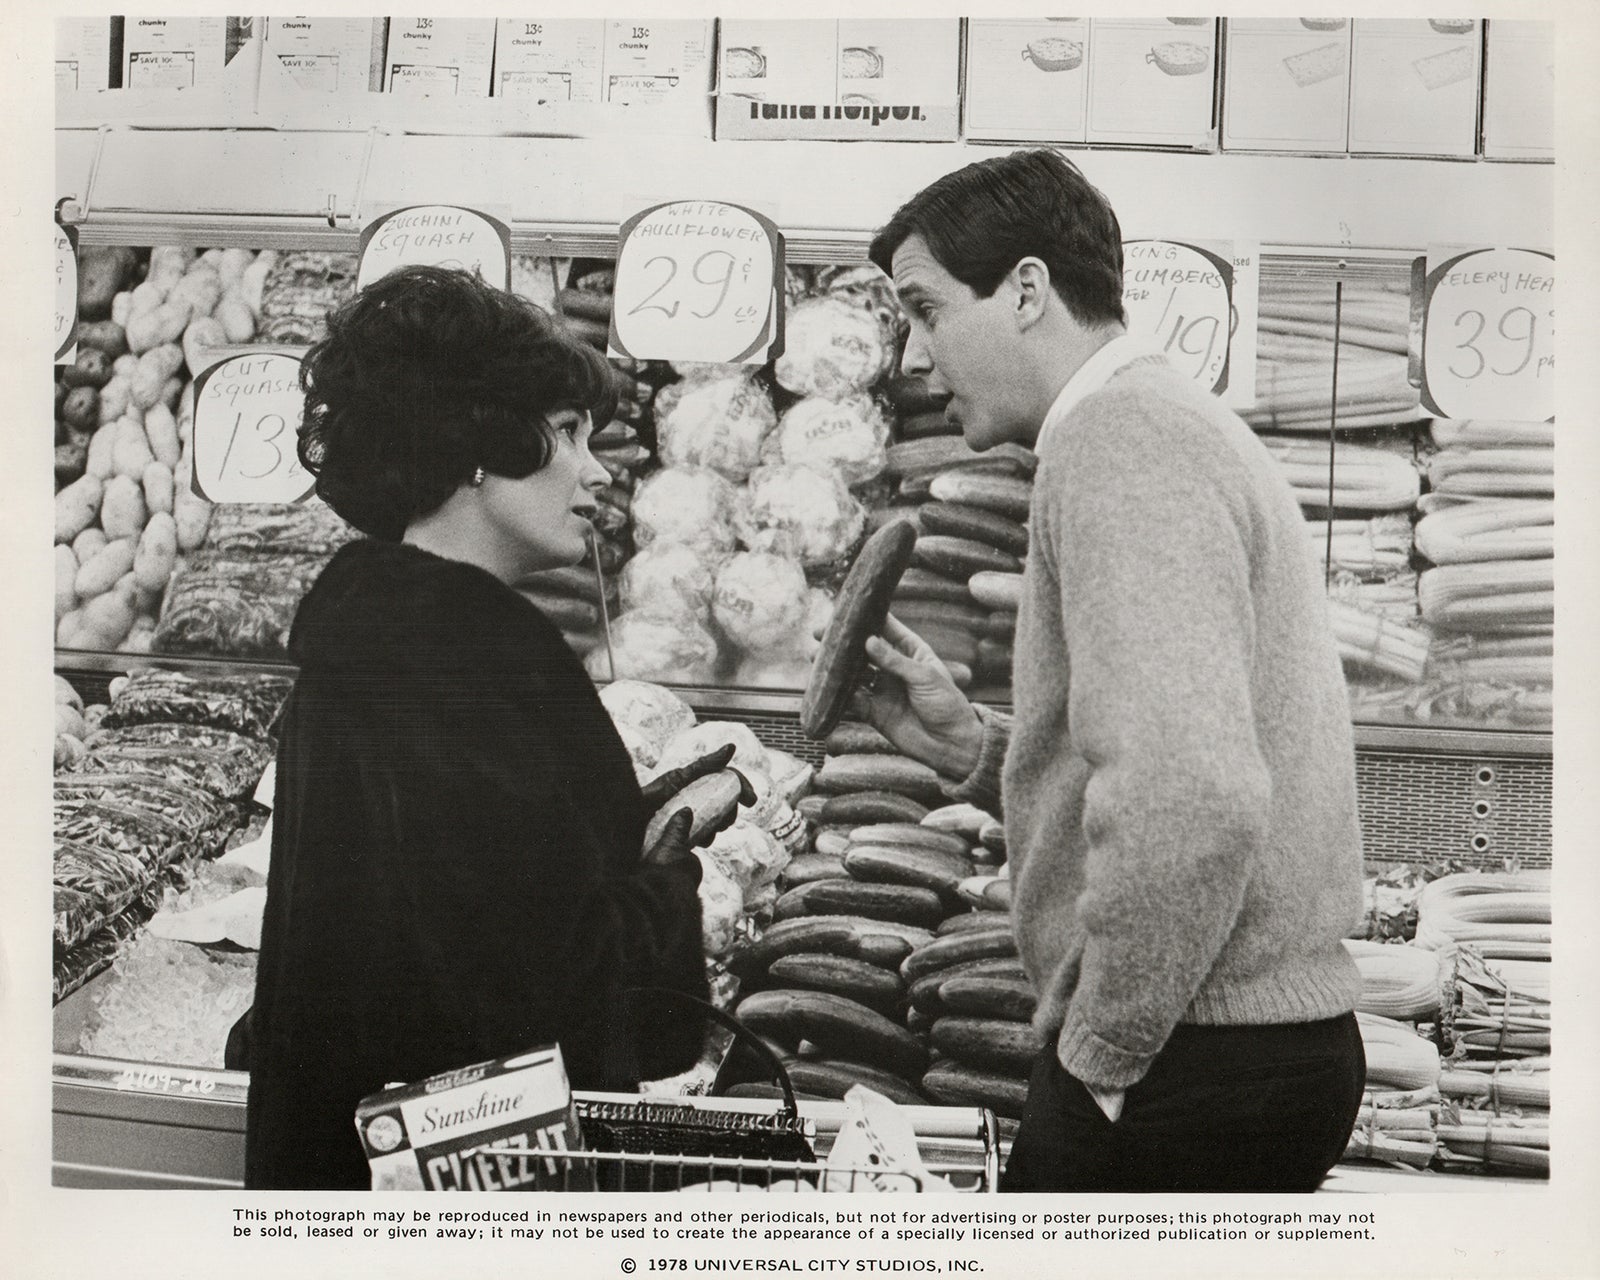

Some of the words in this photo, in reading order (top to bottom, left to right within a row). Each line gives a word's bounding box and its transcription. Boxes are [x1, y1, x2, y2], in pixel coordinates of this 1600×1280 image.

[138, 19, 167, 27] chunky
[416, 17, 433, 29] 13¢
[525, 23, 543, 35] 13¢
[402, 32, 432, 40] chunky
[632, 27, 650, 39] 13¢
[619, 42, 648, 50] chunky
[668, 203, 730, 217] WHITE
[386, 215, 462, 233] ZUCCHINI
[633, 223, 766, 243] CAULIFLOWER
[222, 358, 274, 379] CUT
[420, 1090, 524, 1134] Sunshine
[426, 1121, 573, 1191] CHEEZIT
